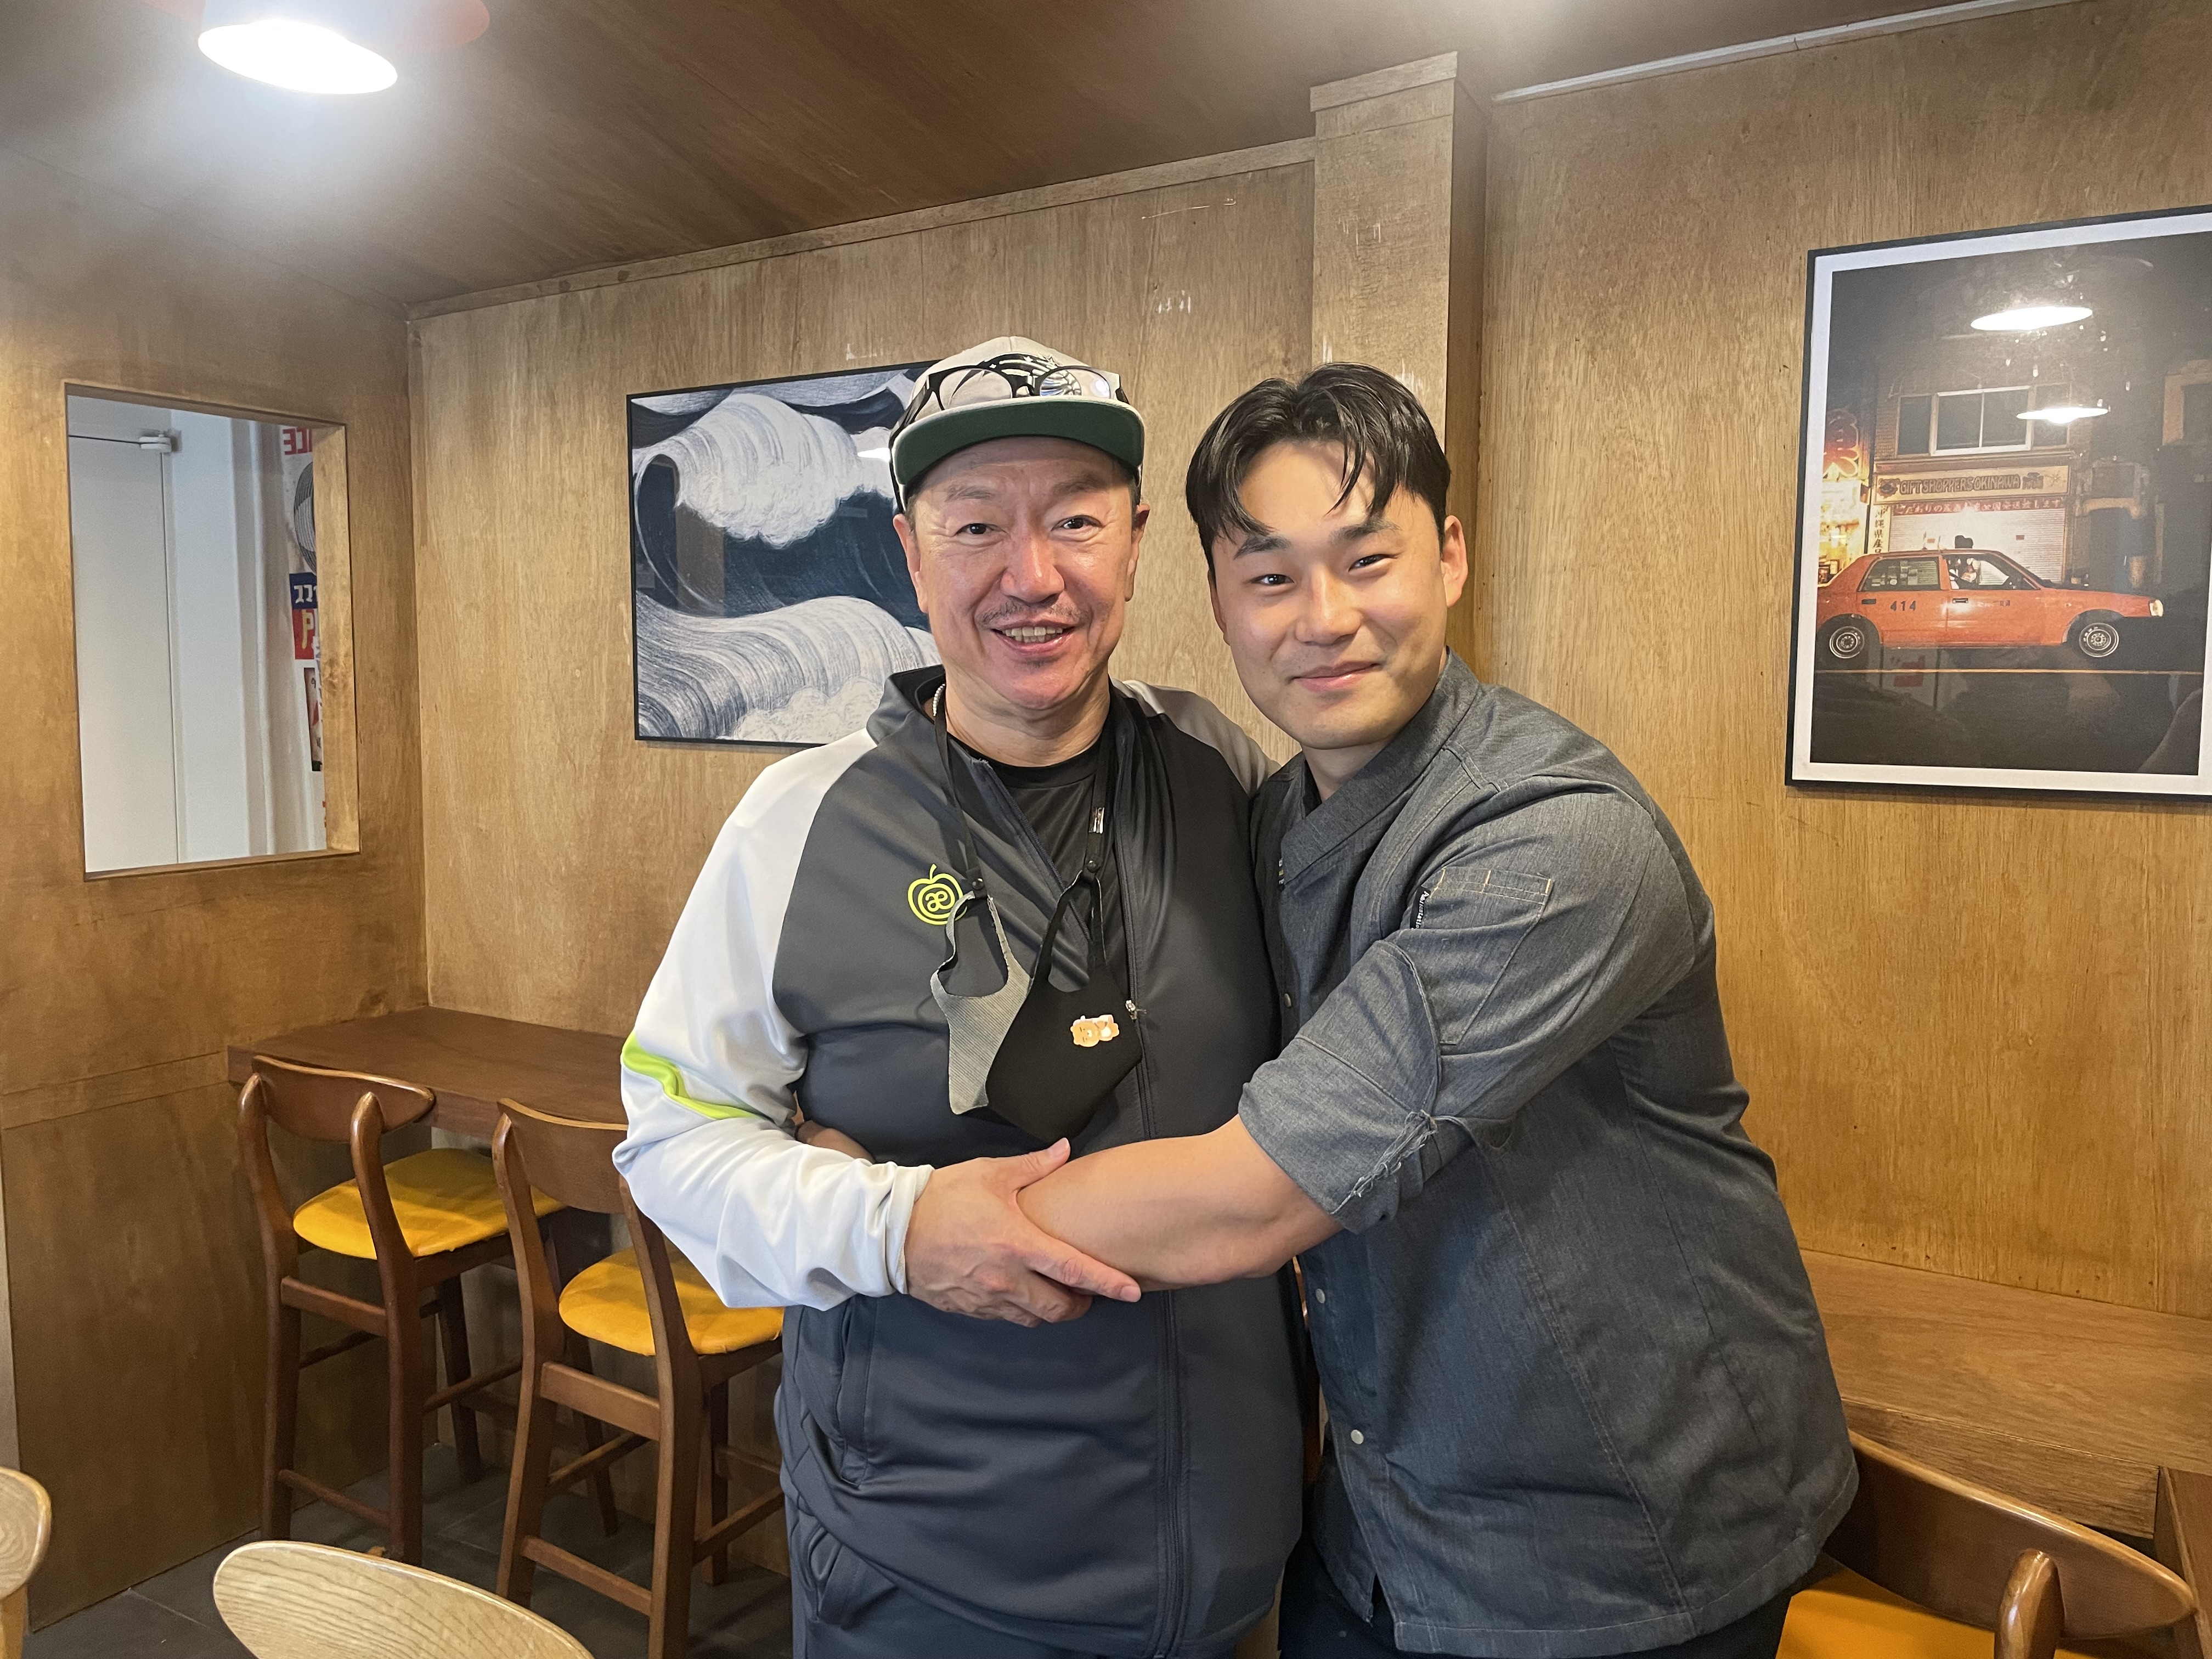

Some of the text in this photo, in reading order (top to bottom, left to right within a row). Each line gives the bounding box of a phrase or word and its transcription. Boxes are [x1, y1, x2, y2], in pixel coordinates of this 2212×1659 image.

[1899, 479, 1922, 495] GIFT
[1922, 476, 1973, 494] SHOPPERS
[1973, 474, 2021, 491] OKINAWA
[1891, 600, 1916, 611] 414
